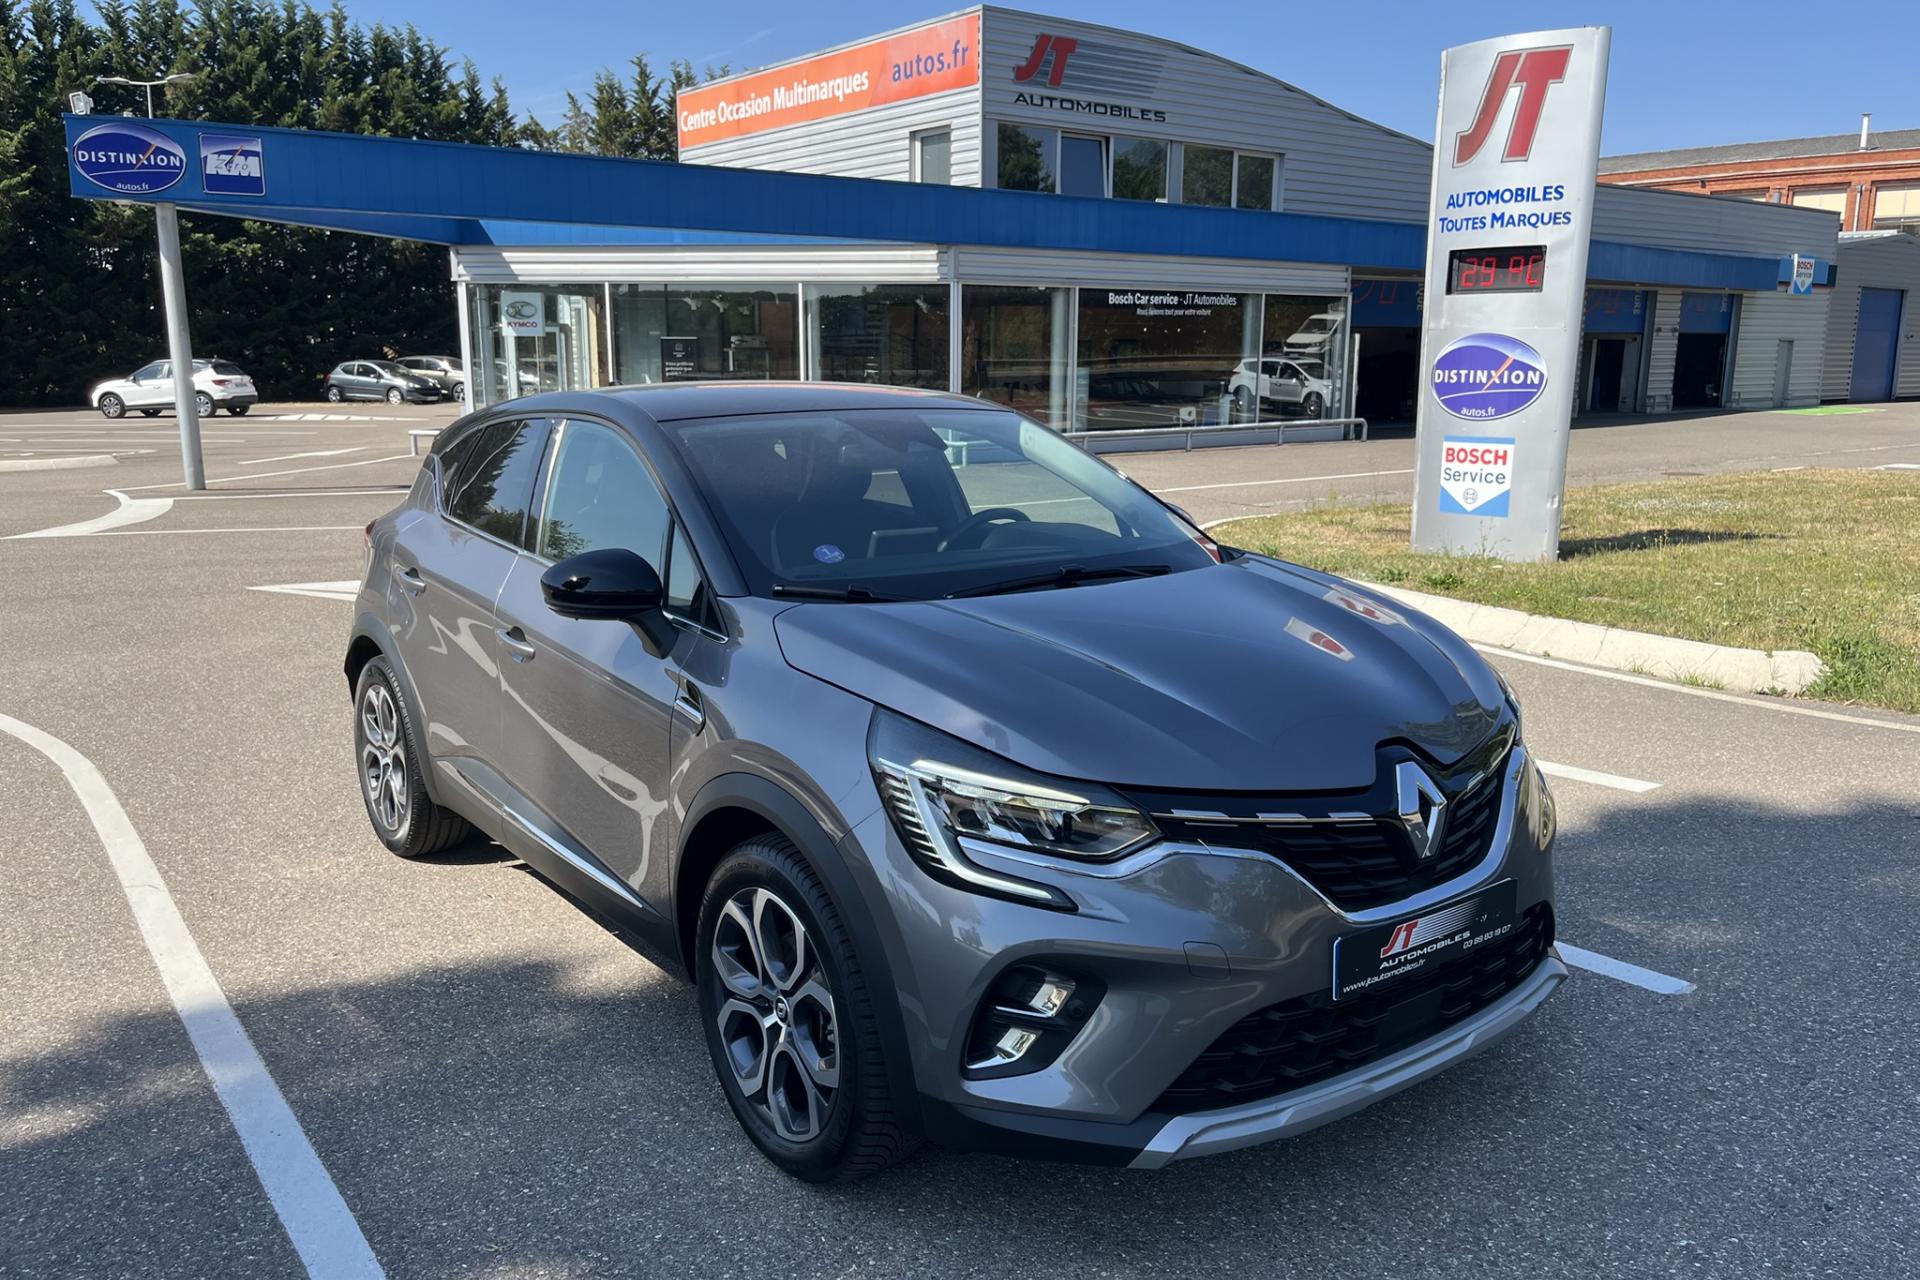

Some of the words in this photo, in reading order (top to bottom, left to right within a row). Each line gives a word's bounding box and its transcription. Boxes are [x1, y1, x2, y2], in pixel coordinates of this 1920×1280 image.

[892, 40, 969, 82] autos.fr
[1013, 34, 1078, 88] JT
[680, 106, 717, 132] Centre
[718, 96, 771, 122] Occasion
[773, 71, 869, 108] Multimarques
[1014, 92, 1166, 123] AUTOMOBILES
[1452, 44, 1574, 168] JT
[78, 150, 181, 167] DISTINXION
[116, 182, 149, 191] autos.fr
[1446, 185, 1565, 209] AUTOMOBILES
[1461, 257, 1497, 287] 29
[1109, 293, 1133, 304] Bosch
[1135, 293, 1149, 304] Car
[1150, 293, 1178, 305] service
[1184, 294, 1193, 305] JT
[1194, 294, 1237, 306] Automobiles
[1435, 369, 1540, 385] DISTINXION
[1460, 406, 1496, 417] autos.fr
[1445, 448, 1508, 465] BOSCH
[1443, 467, 1506, 484] Service
[1379, 930, 1471, 969] AUTOMOBILES
[1380, 919, 1419, 958] JT
